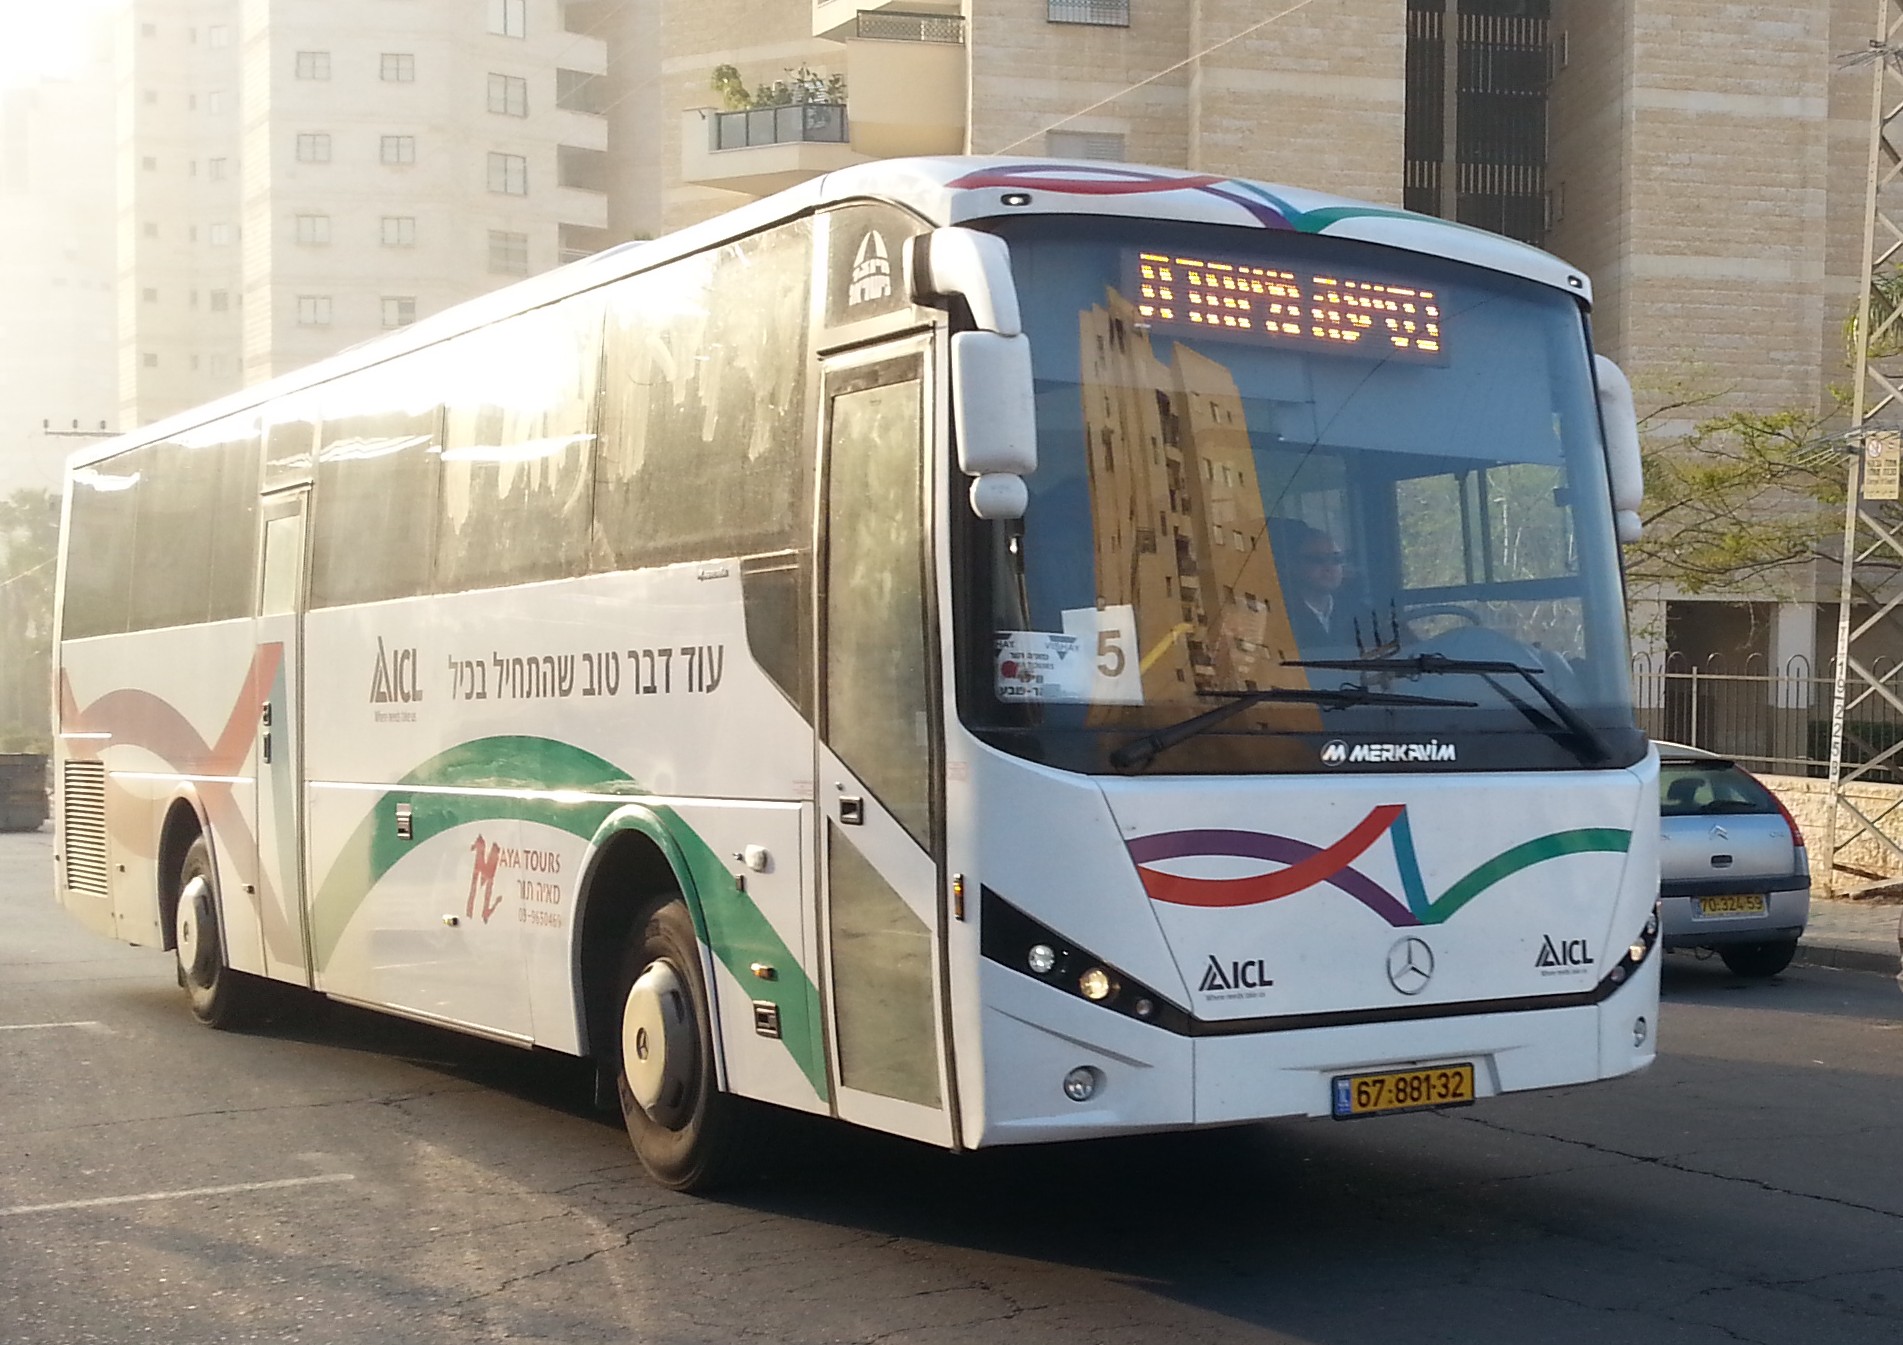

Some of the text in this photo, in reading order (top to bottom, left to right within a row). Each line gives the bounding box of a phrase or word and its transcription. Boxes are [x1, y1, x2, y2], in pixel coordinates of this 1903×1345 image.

[1139, 253, 1440, 351] נסיעה מיוחדת
[448, 644, 724, 700] עוד דבר טוב שהתחיל בכיל
[1097, 629, 1126, 678] 5
[523, 849, 561, 873] TOURS
[537, 882, 560, 904] מאיה
